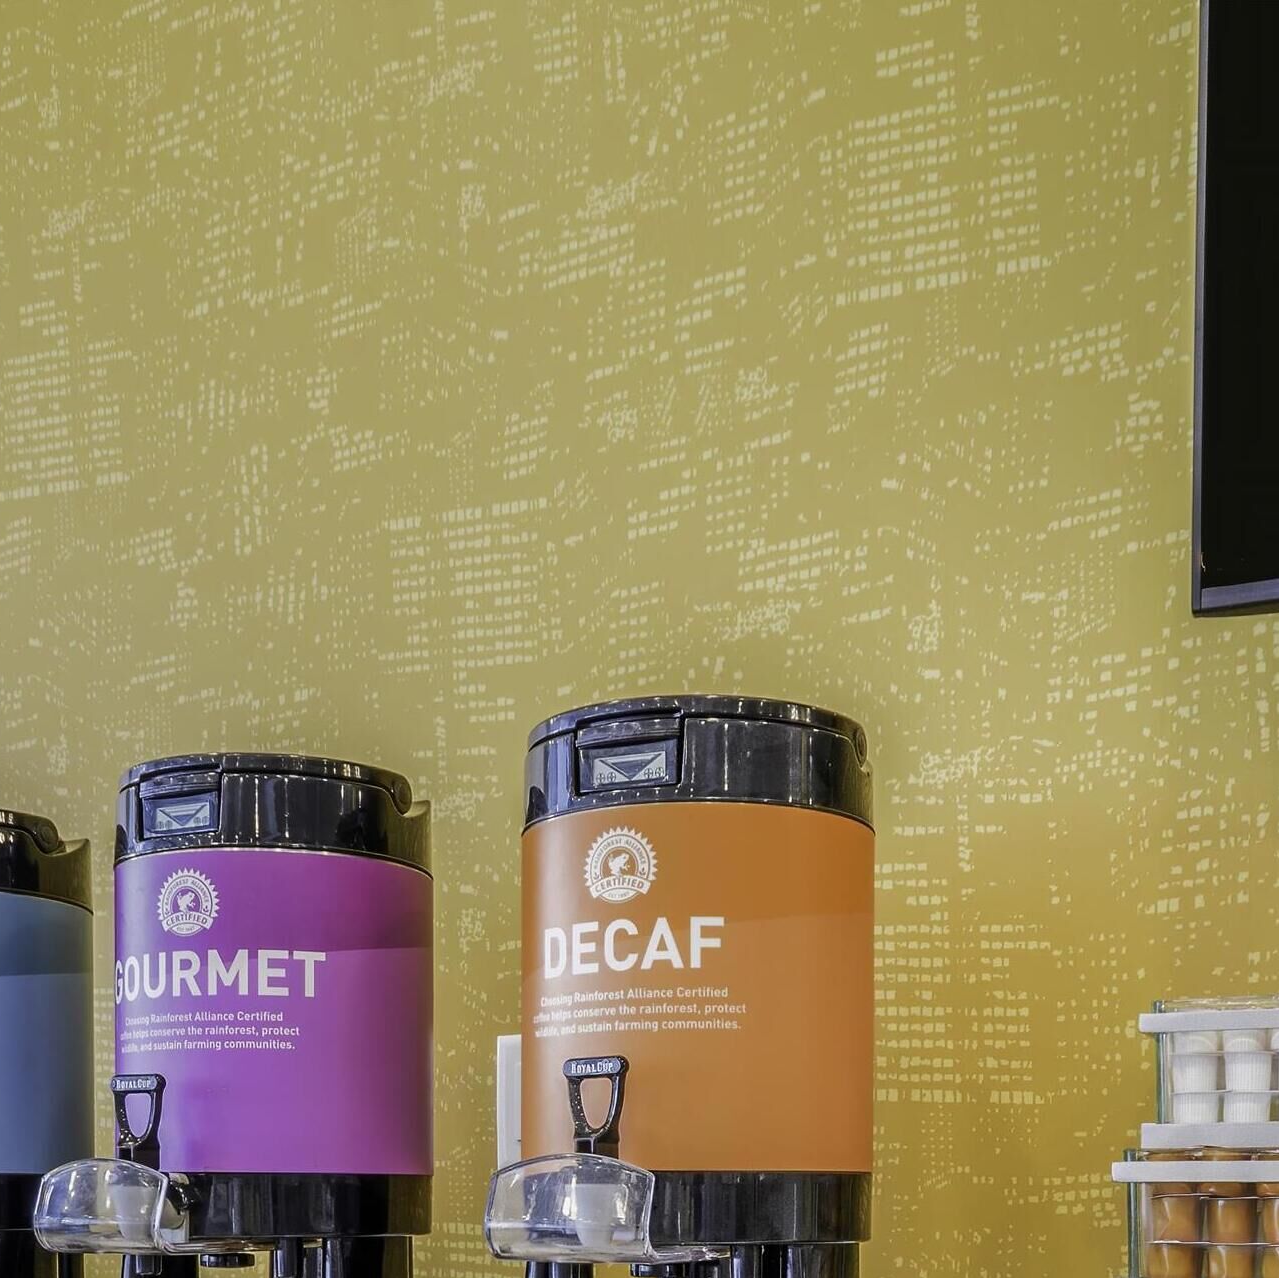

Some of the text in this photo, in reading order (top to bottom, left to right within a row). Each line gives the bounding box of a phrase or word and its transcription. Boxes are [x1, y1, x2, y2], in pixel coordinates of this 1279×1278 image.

[595, 878, 645, 893] CERTIFIED
[166, 913, 208, 927] CERTIFIED
[544, 916, 725, 980] DECAF
[115, 949, 326, 1005] GOURMET
[574, 990, 625, 1003] Rainforest
[627, 988, 673, 999] Alliance
[676, 987, 729, 998] Certified
[150, 1012, 193, 1025] Rainforest
[194, 1011, 235, 1022] Alliance
[237, 1011, 284, 1022] Certified
[573, 1006, 617, 1019] conserve
[619, 1005, 637, 1016] the
[639, 1003, 701, 1016] rainforest,
[704, 1003, 747, 1016] protect
[149, 1027, 186, 1038] conserve
[187, 1025, 203, 1036] the
[205, 1025, 259, 1037] rainforest,
[261, 1026, 300, 1039] protect
[561, 1023, 576, 1035] and
[577, 1022, 612, 1034] sustain
[614, 1020, 659, 1033] farming
[661, 1018, 741, 1031] communities.
[153, 1040, 182, 1051] sustain
[184, 1039, 221, 1051] farming
[223, 1038, 296, 1050] communities.
